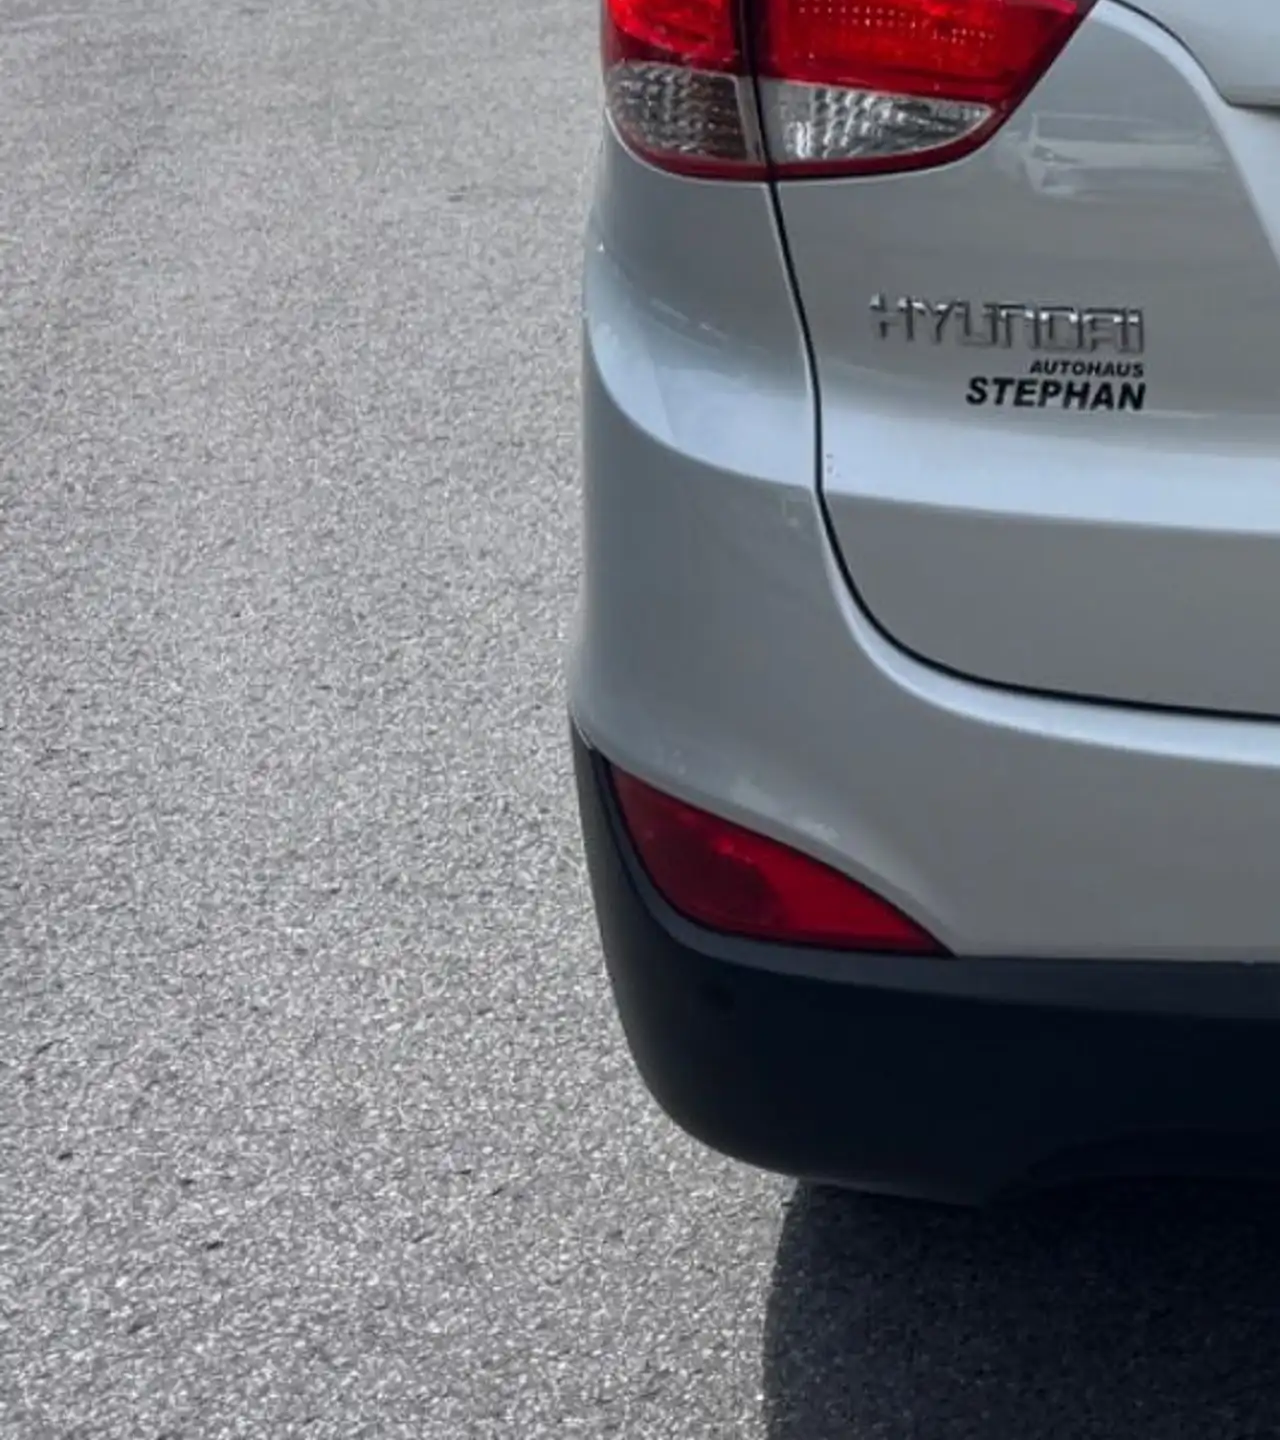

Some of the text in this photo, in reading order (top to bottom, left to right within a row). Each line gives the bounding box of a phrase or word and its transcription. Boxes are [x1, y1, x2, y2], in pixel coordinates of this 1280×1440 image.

[869, 295, 1145, 354] HYUNDAI
[1029, 360, 1145, 378] AUTOHAUS
[965, 376, 1146, 411] STEPHAN
